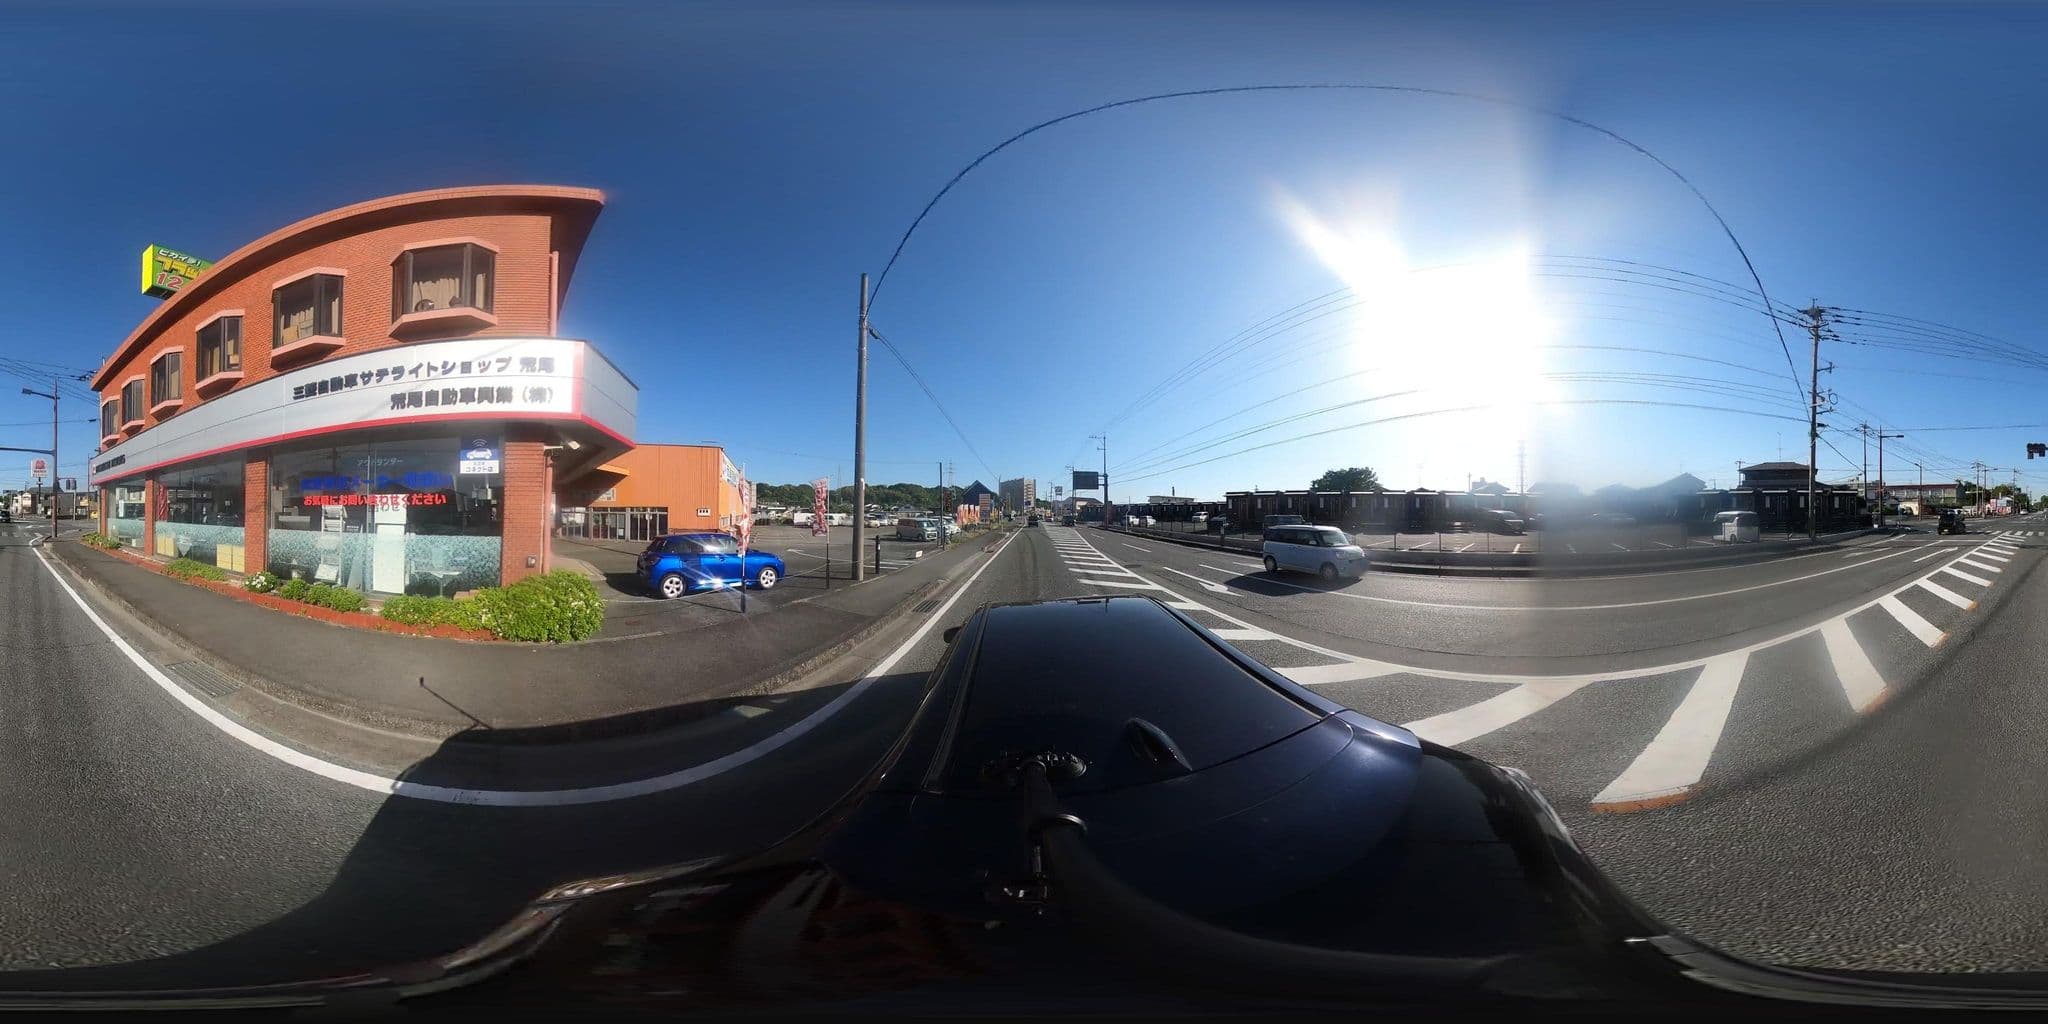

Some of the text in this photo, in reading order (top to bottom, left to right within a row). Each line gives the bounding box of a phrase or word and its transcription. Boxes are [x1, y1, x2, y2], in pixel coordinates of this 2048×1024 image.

[303, 492, 447, 507] お気軽にお問い合わせください
